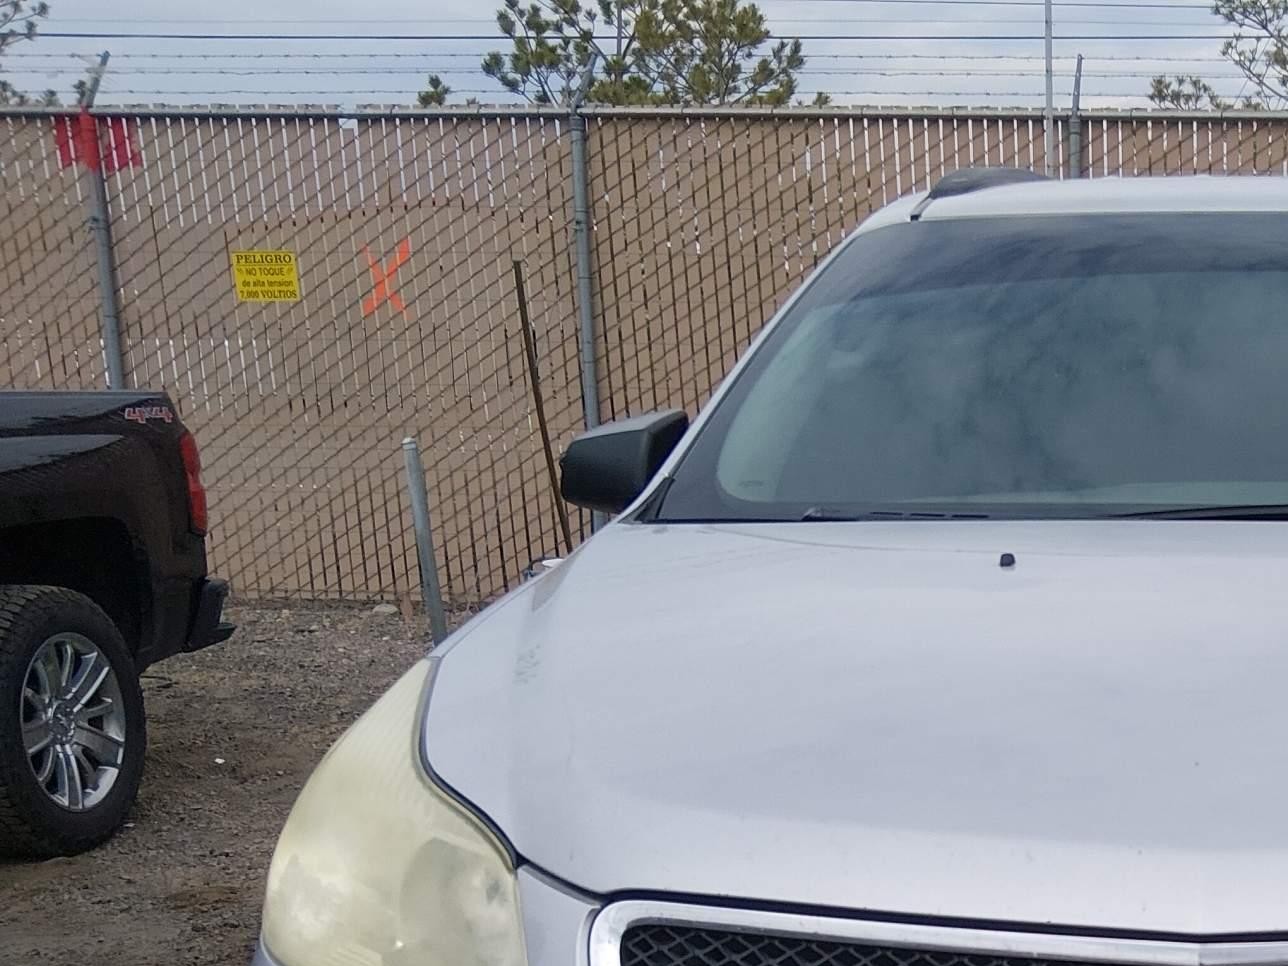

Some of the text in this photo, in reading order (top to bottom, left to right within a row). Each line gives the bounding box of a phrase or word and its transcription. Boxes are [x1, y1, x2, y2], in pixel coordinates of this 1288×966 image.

[235, 254, 292, 264] PELIGRO
[246, 267, 285, 276] NO TOQUE
[242, 279, 251, 288] de
[252, 279, 265, 288] alta
[260, 289, 297, 299] VOLTIOS
